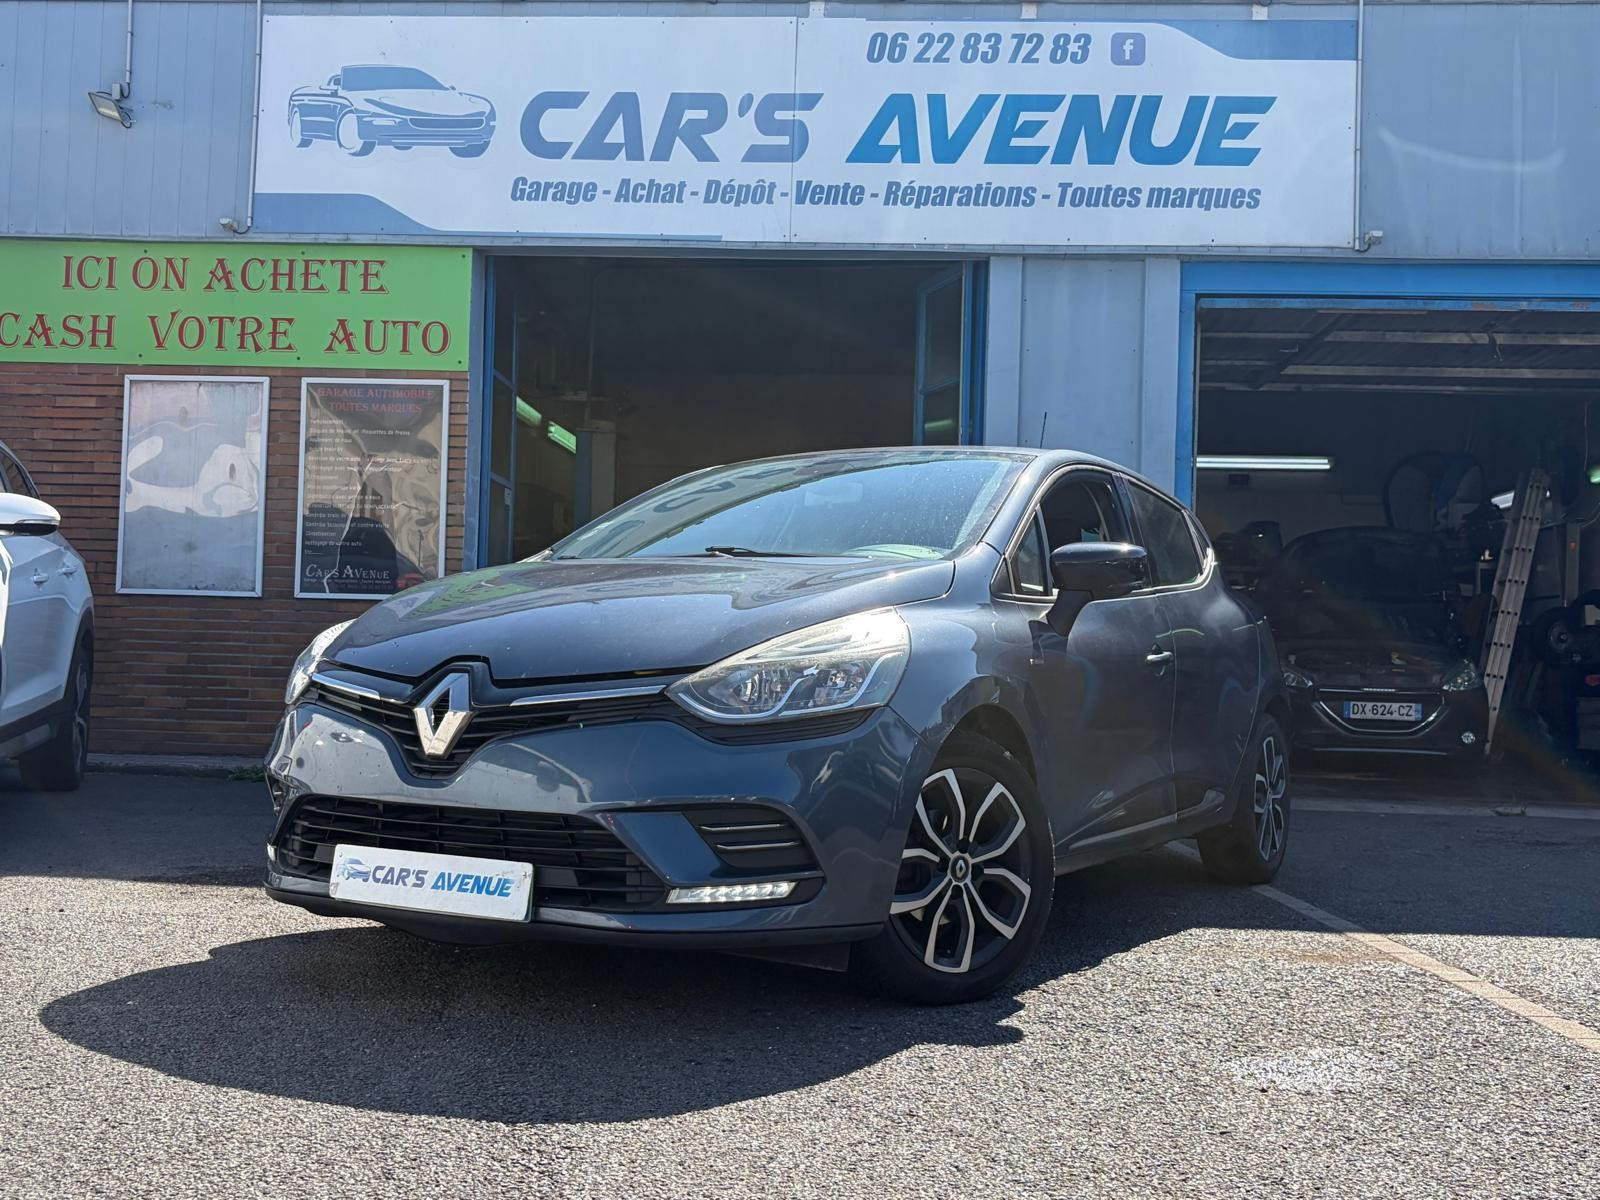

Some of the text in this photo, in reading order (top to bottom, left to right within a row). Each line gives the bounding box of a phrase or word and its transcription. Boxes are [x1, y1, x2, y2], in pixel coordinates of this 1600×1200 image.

[866, 31, 1092, 65] 06 22 83 72 83
[520, 90, 1278, 167] CAR'S AVENUE
[511, 176, 597, 206] Garage
[614, 178, 687, 204] Achat
[703, 179, 777, 208] Dépôt
[794, 180, 865, 207] Vente
[883, 180, 1037, 210] Réparations
[1057, 182, 1142, 209] Toutes
[1146, 187, 1262, 212] marques
[62, 256, 389, 294] ICI ON ACHETE
[0, 309, 450, 355] CASH VOTRE AUTO
[317, 387, 434, 400] GARAGE AUTOMOBILE
[328, 402, 423, 414] TOUTES MARQUES
[372, 865, 515, 898] CAR'S AVENUE
